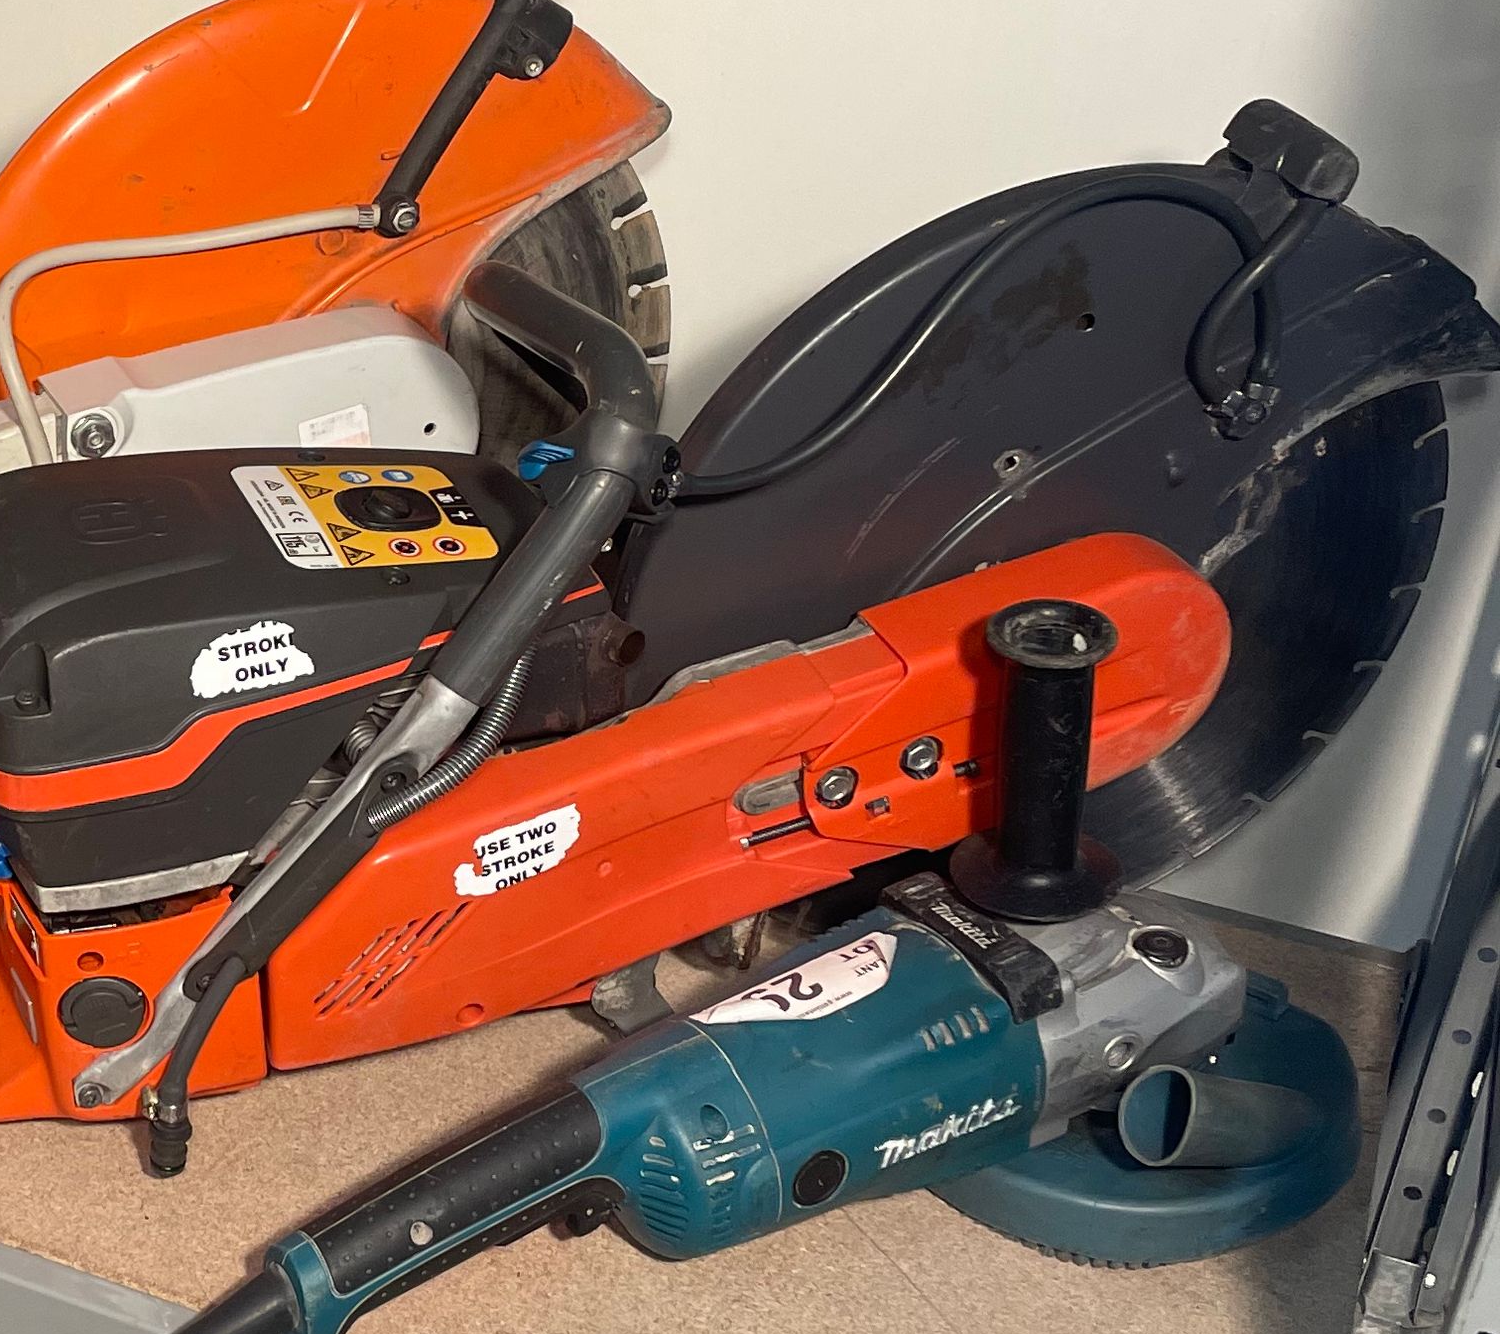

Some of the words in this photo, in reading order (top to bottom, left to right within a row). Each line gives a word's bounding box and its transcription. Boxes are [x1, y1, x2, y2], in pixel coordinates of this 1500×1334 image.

[235, 657, 288, 681] ONLY
[474, 837, 511, 859] USE
[515, 822, 556, 844] TWO
[481, 841, 555, 877] STROKE
